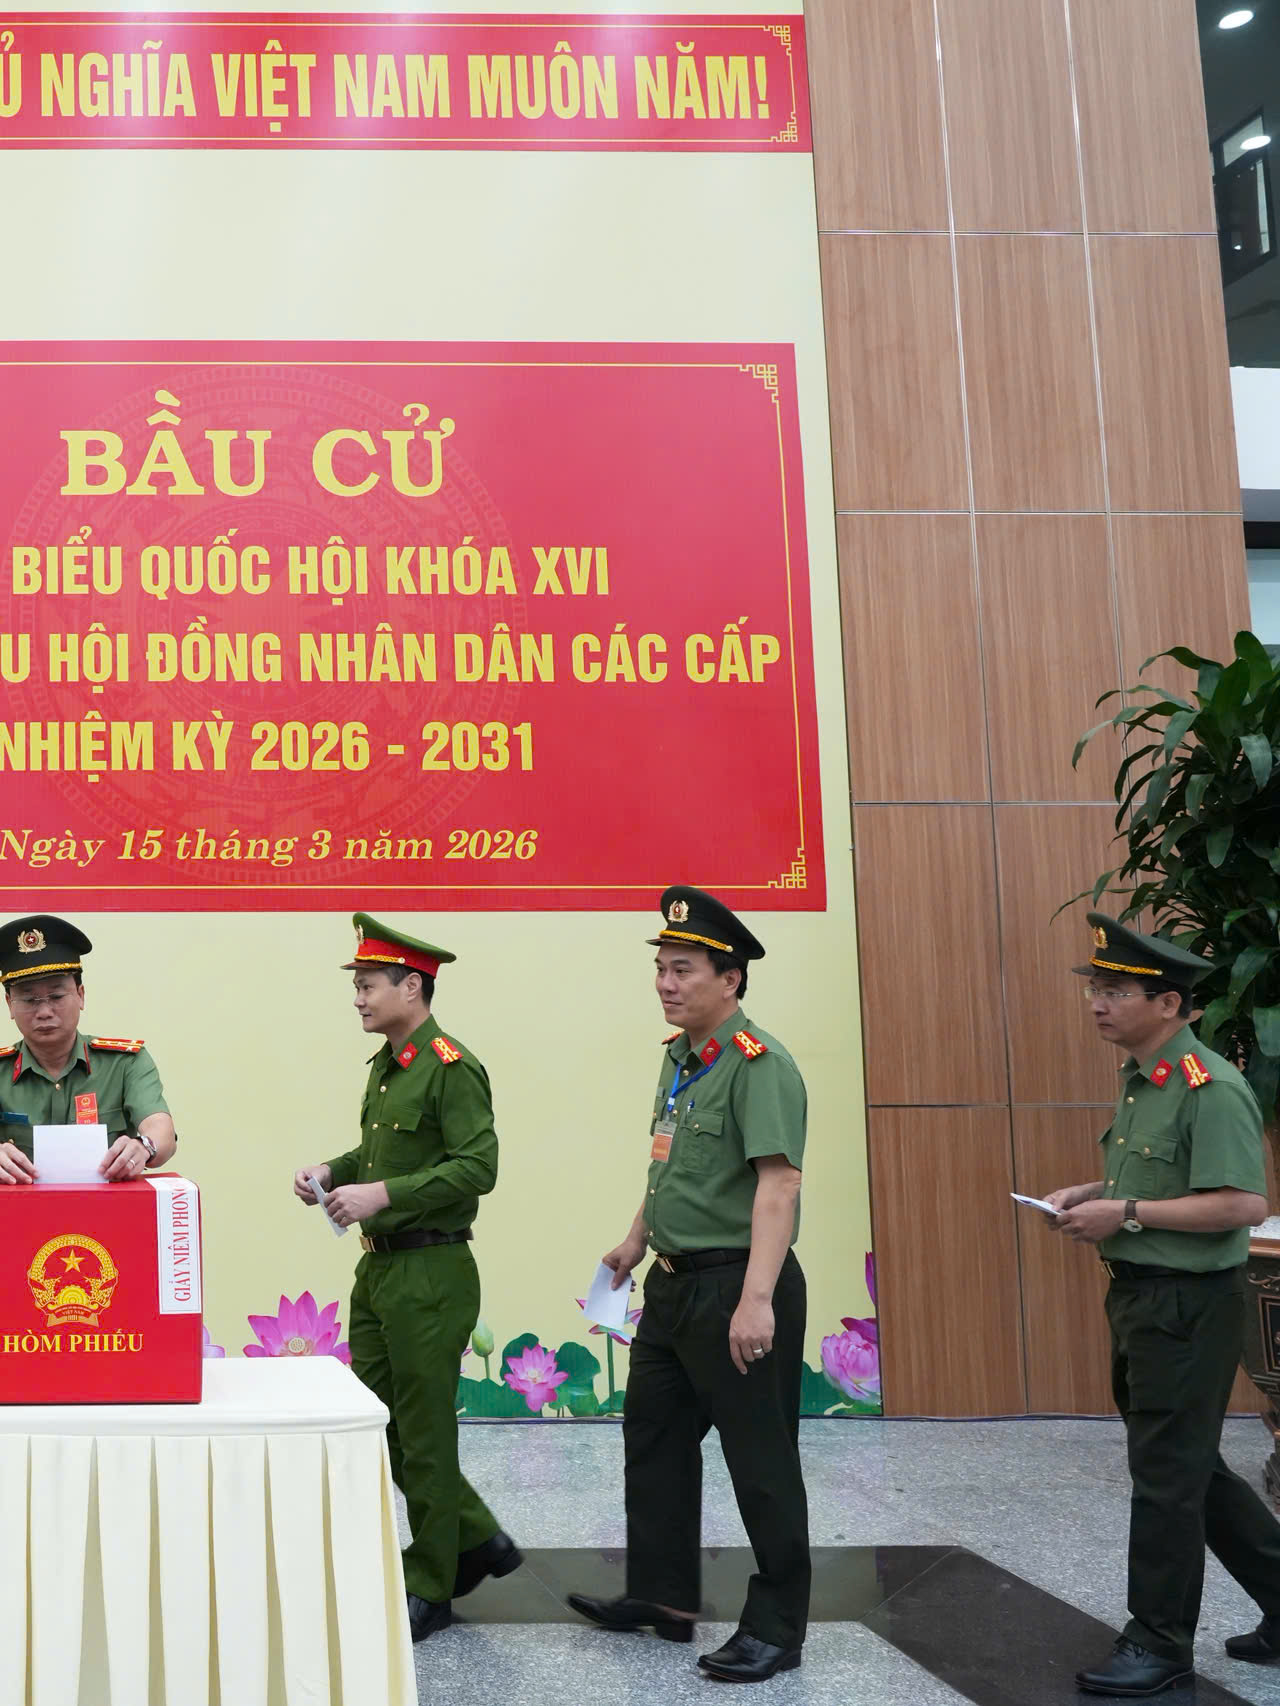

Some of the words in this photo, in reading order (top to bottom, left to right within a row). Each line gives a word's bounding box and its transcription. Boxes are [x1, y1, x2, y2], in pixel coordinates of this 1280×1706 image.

[41, 40, 196, 117] NGHĨA
[211, 40, 316, 132] VIỆT
[334, 54, 450, 118] NAM
[469, 41, 618, 118] MUÔN
[634, 41, 770, 119] NĂM!
[60, 390, 270, 496] BẦU
[313, 403, 456, 496] CỬ
[13, 526, 122, 595] BIỂU
[140, 528, 271, 601] QUỐC
[289, 535, 368, 605] HỘI
[386, 535, 517, 595] KHÓA
[532, 547, 609, 595] XVI
[49, 623, 129, 693] HỘI
[146, 615, 282, 683] ĐỒNG
[300, 623, 437, 682] NHÂN
[454, 623, 554, 683] DÂN
[572, 623, 668, 683] CÁC
[685, 615, 781, 683] CẤP
[173, 710, 234, 771] KỲ
[250, 721, 370, 771] 2026
[387, 744, 405, 755] -
[423, 721, 533, 771] 2031
[118, 829, 163, 860] 15
[176, 828, 299, 867] tháng
[308, 829, 332, 860] 3
[343, 831, 433, 860] năm
[444, 829, 538, 860] 2026
[167, 1231, 191, 1266] NIÊM
[3, 1329, 62, 1353] HÒM
[68, 1328, 144, 1353] PHIẾU
